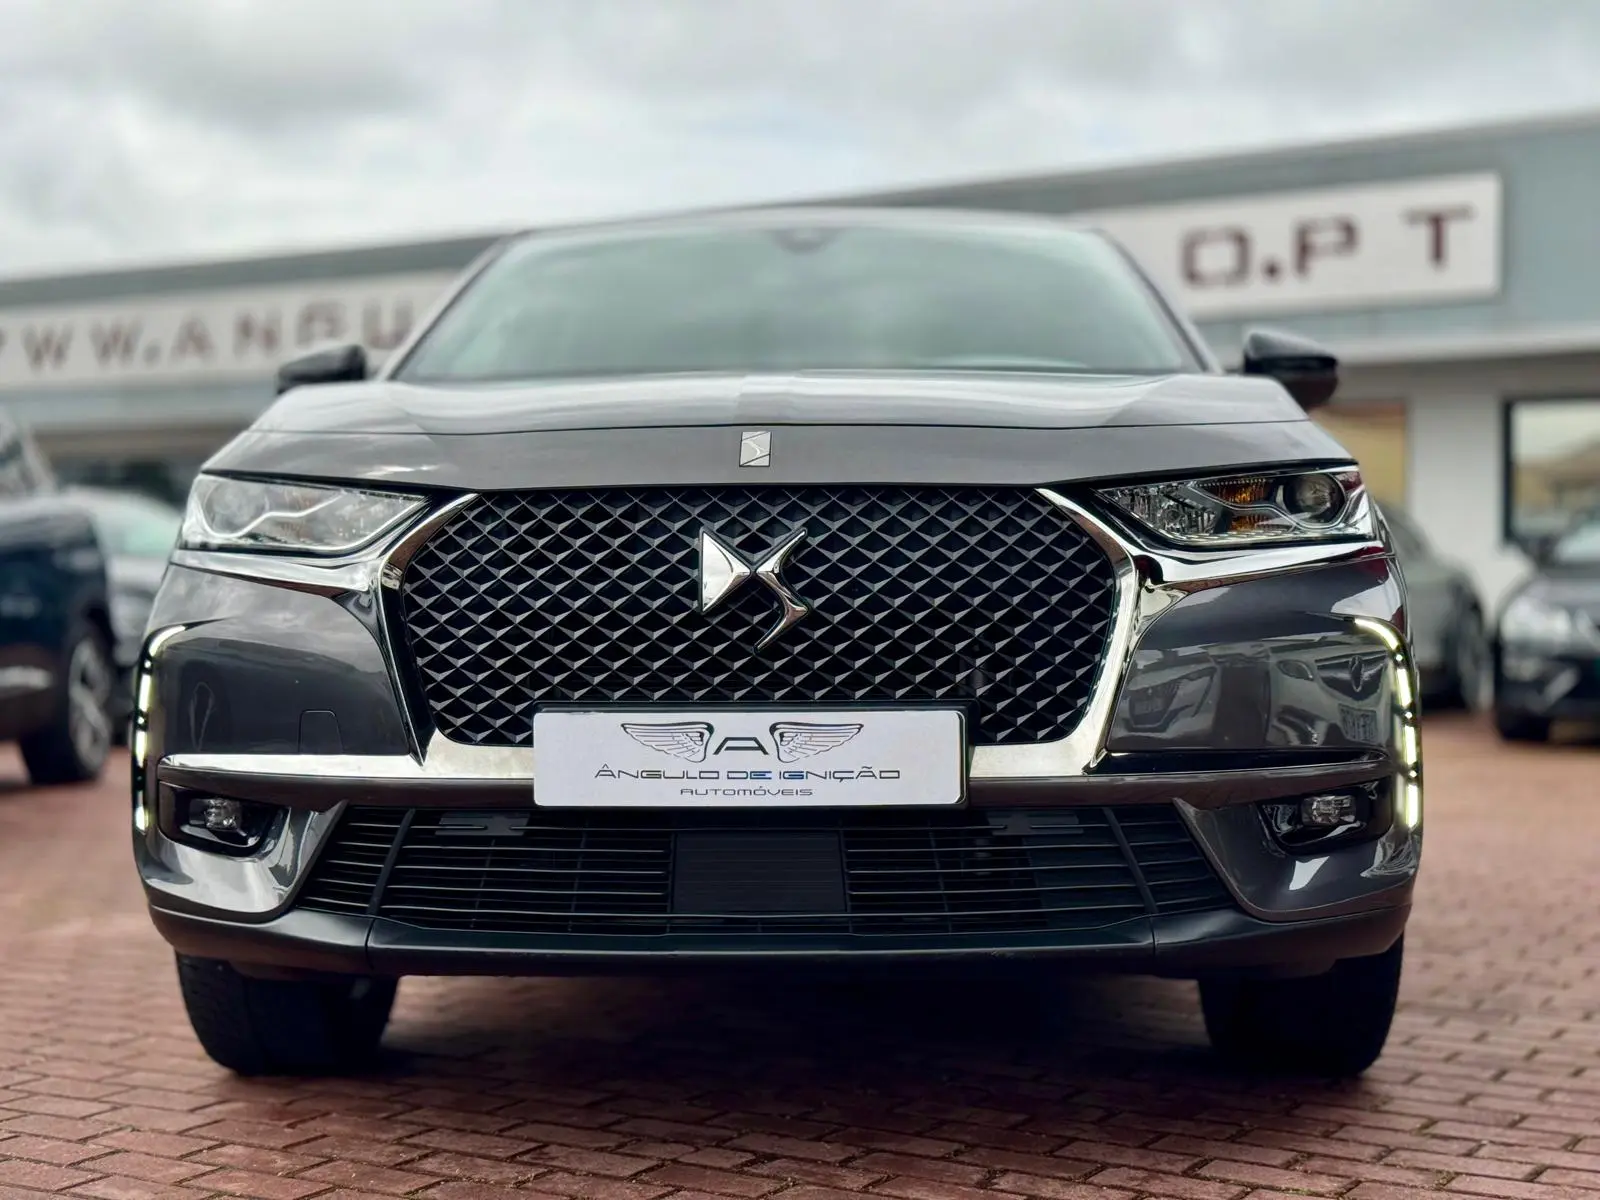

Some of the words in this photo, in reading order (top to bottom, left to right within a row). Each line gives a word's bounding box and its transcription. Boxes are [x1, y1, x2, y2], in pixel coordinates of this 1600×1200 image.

[713, 736, 769, 756] A
[594, 763, 720, 780] ÂNGULO
[726, 770, 773, 780] DE
[778, 765, 901, 783] IGNIÇÃO
[680, 785, 814, 797] AUTOMÓVEIS
